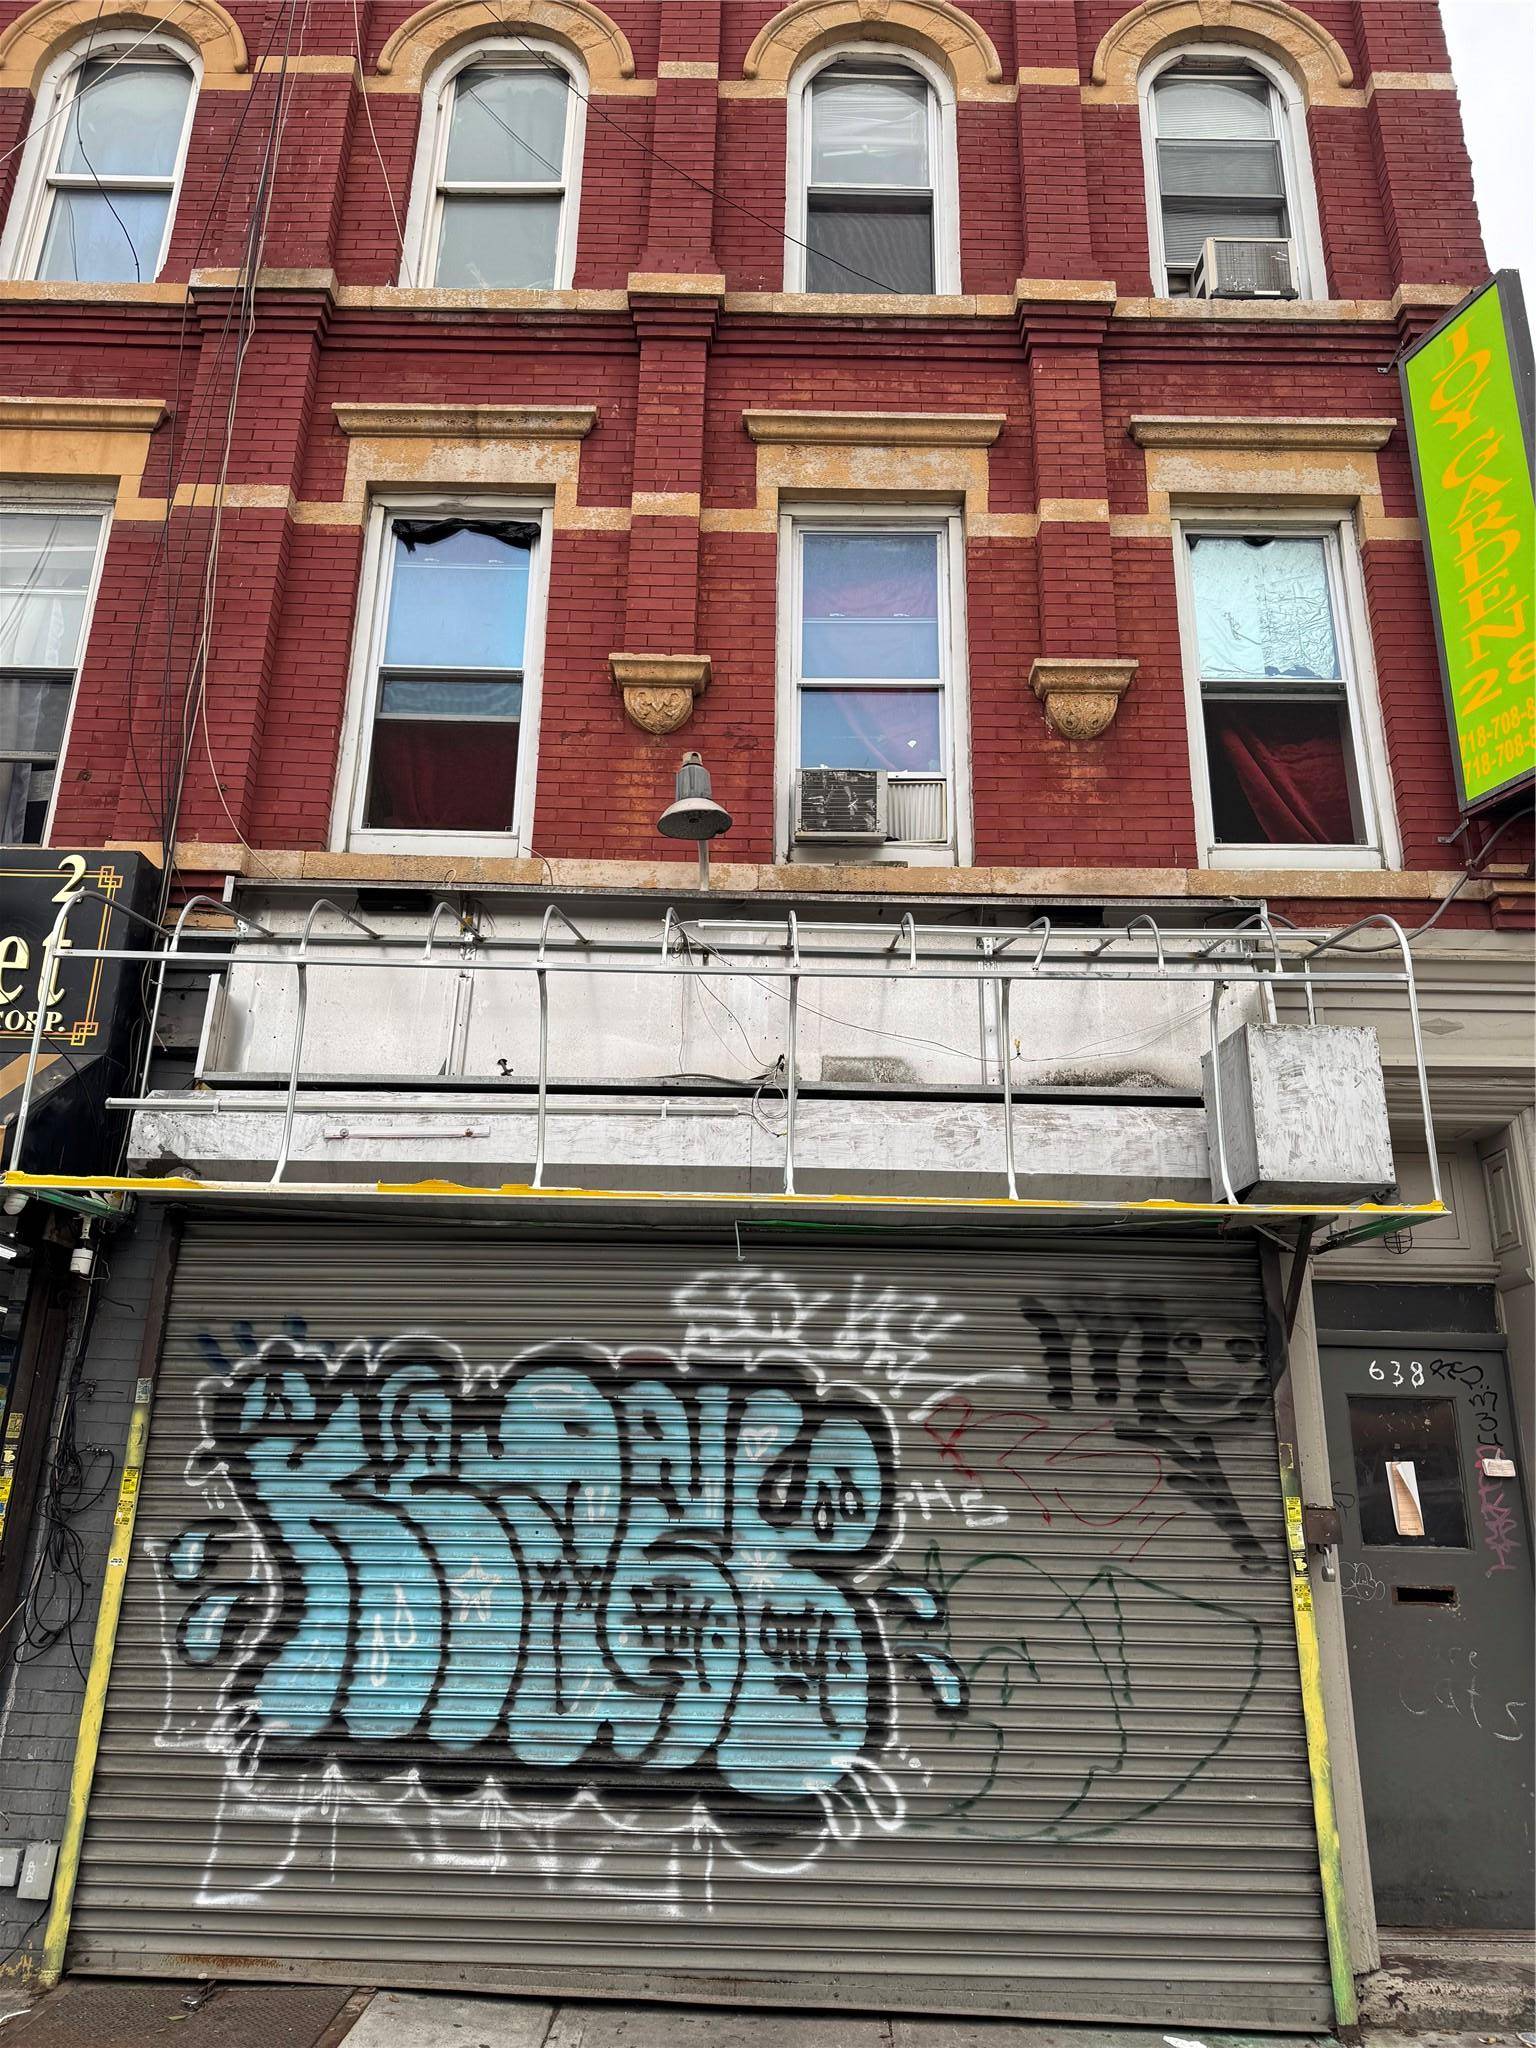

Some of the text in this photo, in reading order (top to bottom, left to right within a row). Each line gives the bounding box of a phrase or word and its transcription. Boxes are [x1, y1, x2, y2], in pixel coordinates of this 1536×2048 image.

[1429, 316, 1530, 669] JOY GARDEN
[52, 854, 87, 903] 2
[0, 1009, 67, 1032] ORP.
[1369, 1360, 1426, 1388] 638
